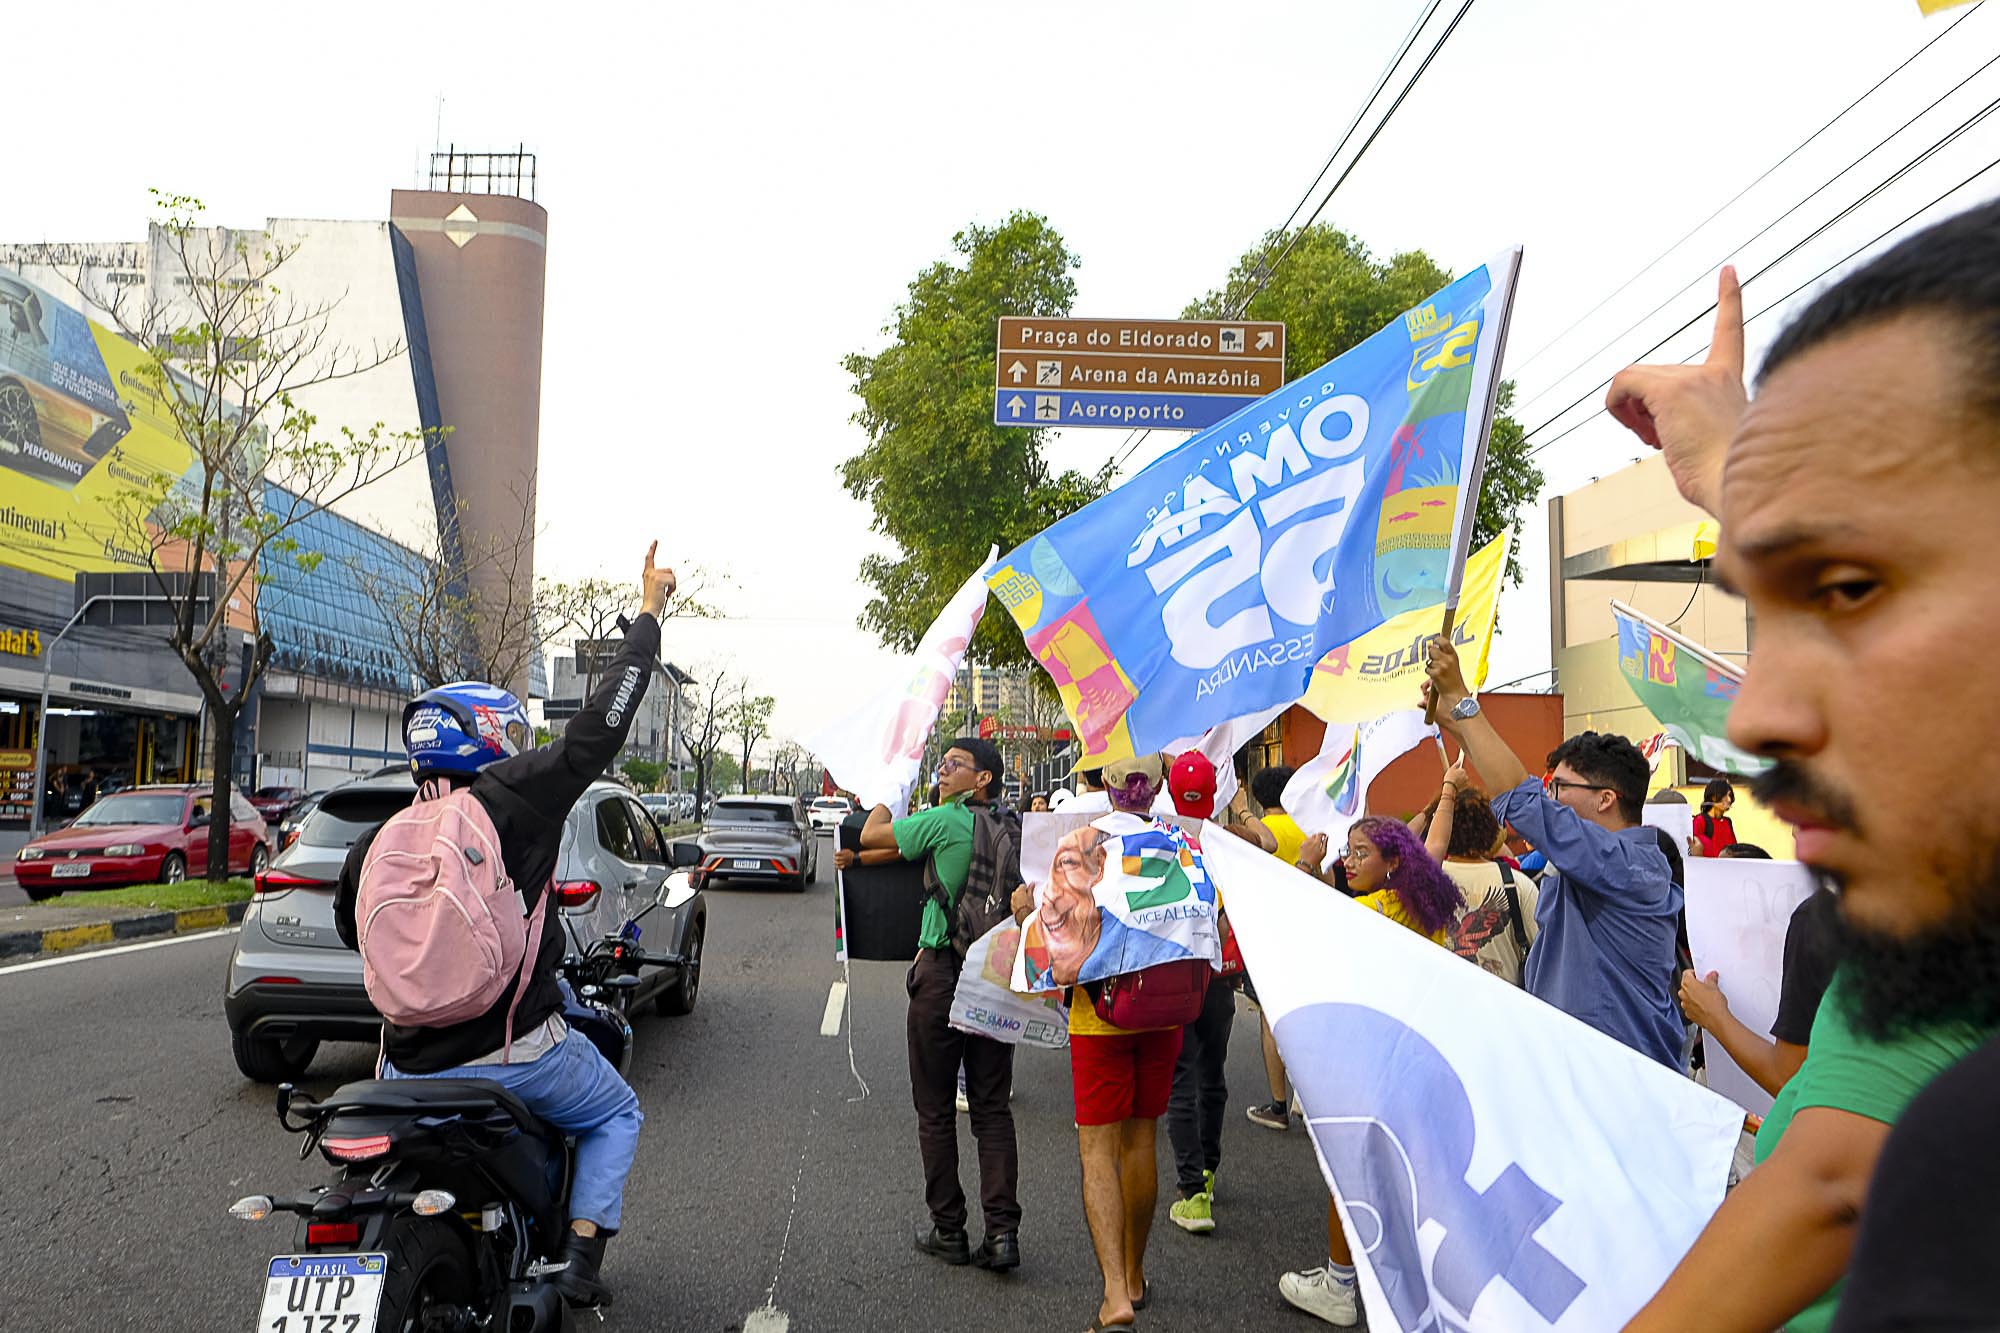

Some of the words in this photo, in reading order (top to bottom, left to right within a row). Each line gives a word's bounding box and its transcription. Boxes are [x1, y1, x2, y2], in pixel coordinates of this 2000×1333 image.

[1021, 327, 1078, 348] Praça
[1087, 329, 1111, 346] do
[1119, 329, 1212, 348] Eldorado
[1069, 365, 1127, 384] Arena
[1135, 367, 1158, 385] da
[1164, 366, 1260, 388] Amazônia
[1069, 402, 1185, 423] Aeroporto
[23, 442, 83, 475] PERFORMANCE
[108, 462, 149, 488] Continental
[613, 665, 641, 713] YAMAHA
[1133, 910, 1162, 925] VICE
[305, 1263, 348, 1275] BRASIL
[287, 1276, 355, 1312] UTP
